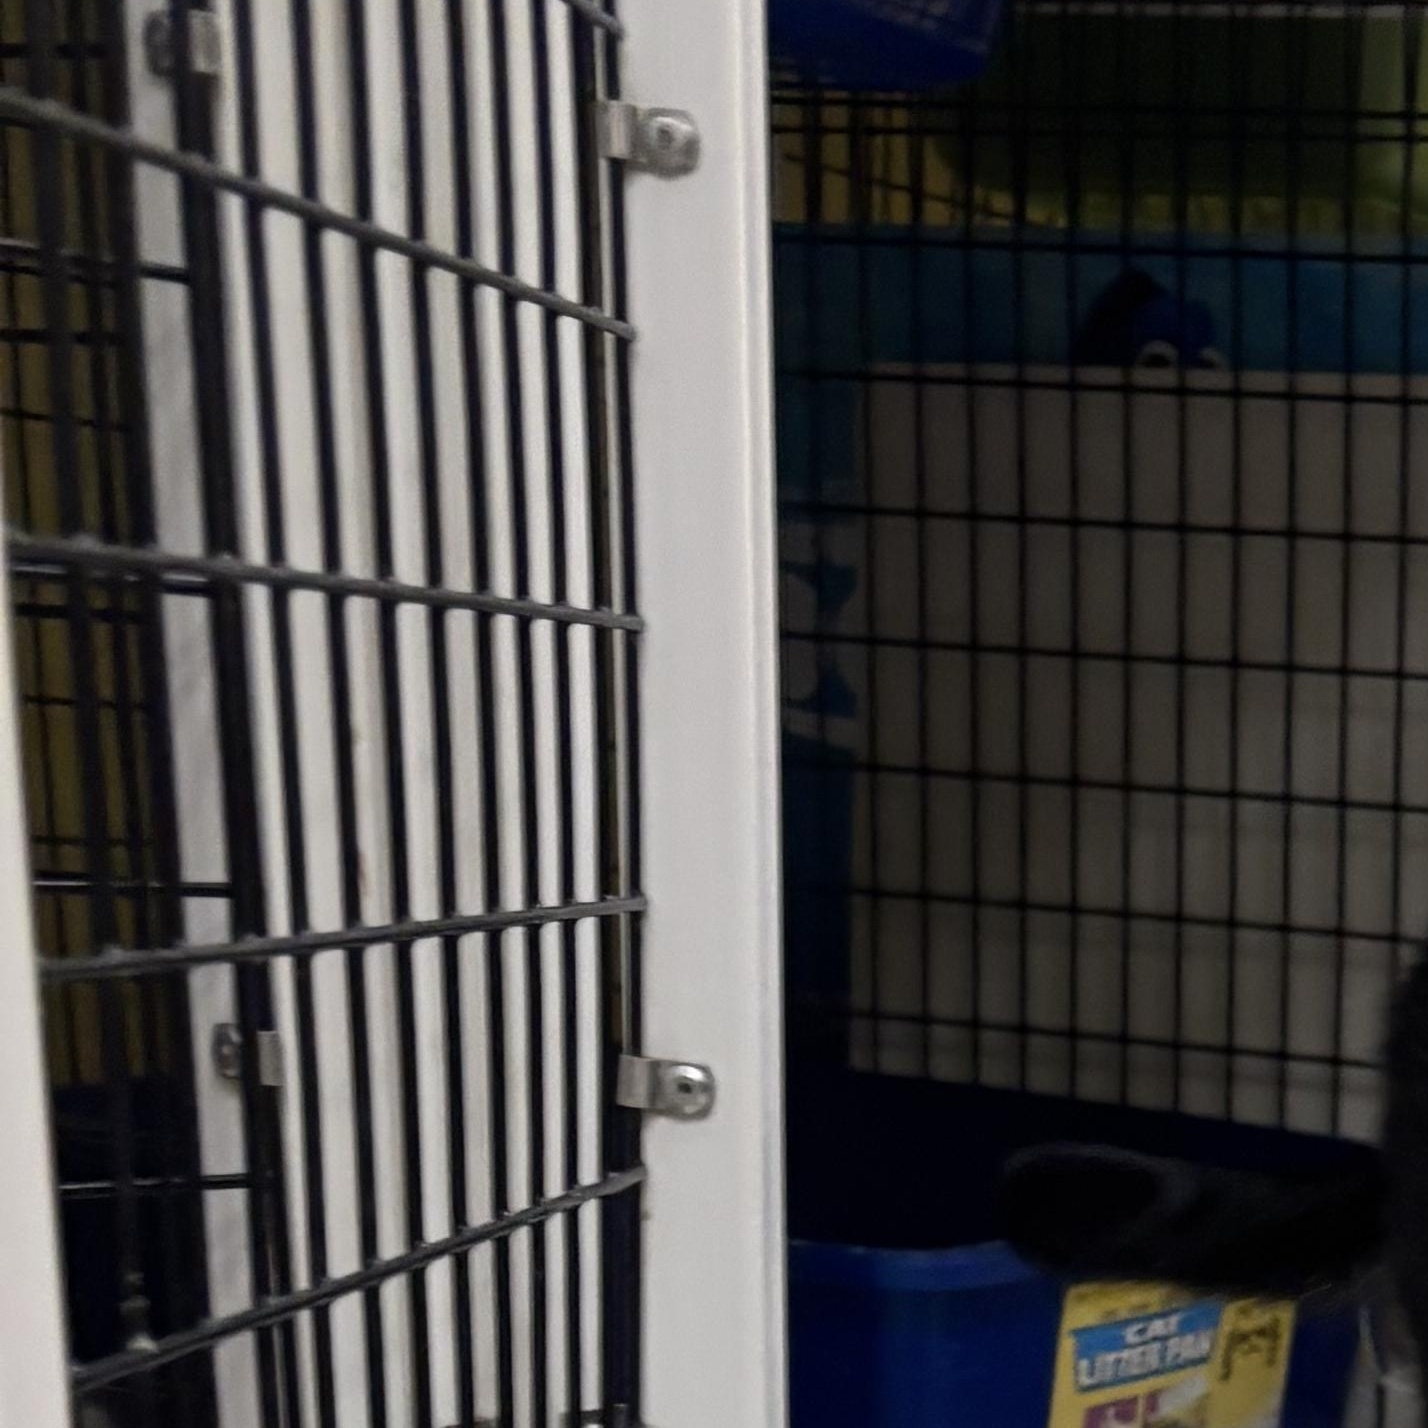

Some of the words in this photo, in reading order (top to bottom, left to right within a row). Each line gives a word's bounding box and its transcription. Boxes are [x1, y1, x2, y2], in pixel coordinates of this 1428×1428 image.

[1123, 1313, 1181, 1345] CAT
[1077, 1342, 1163, 1386] LITTER
[1164, 1329, 1213, 1365] PAN
